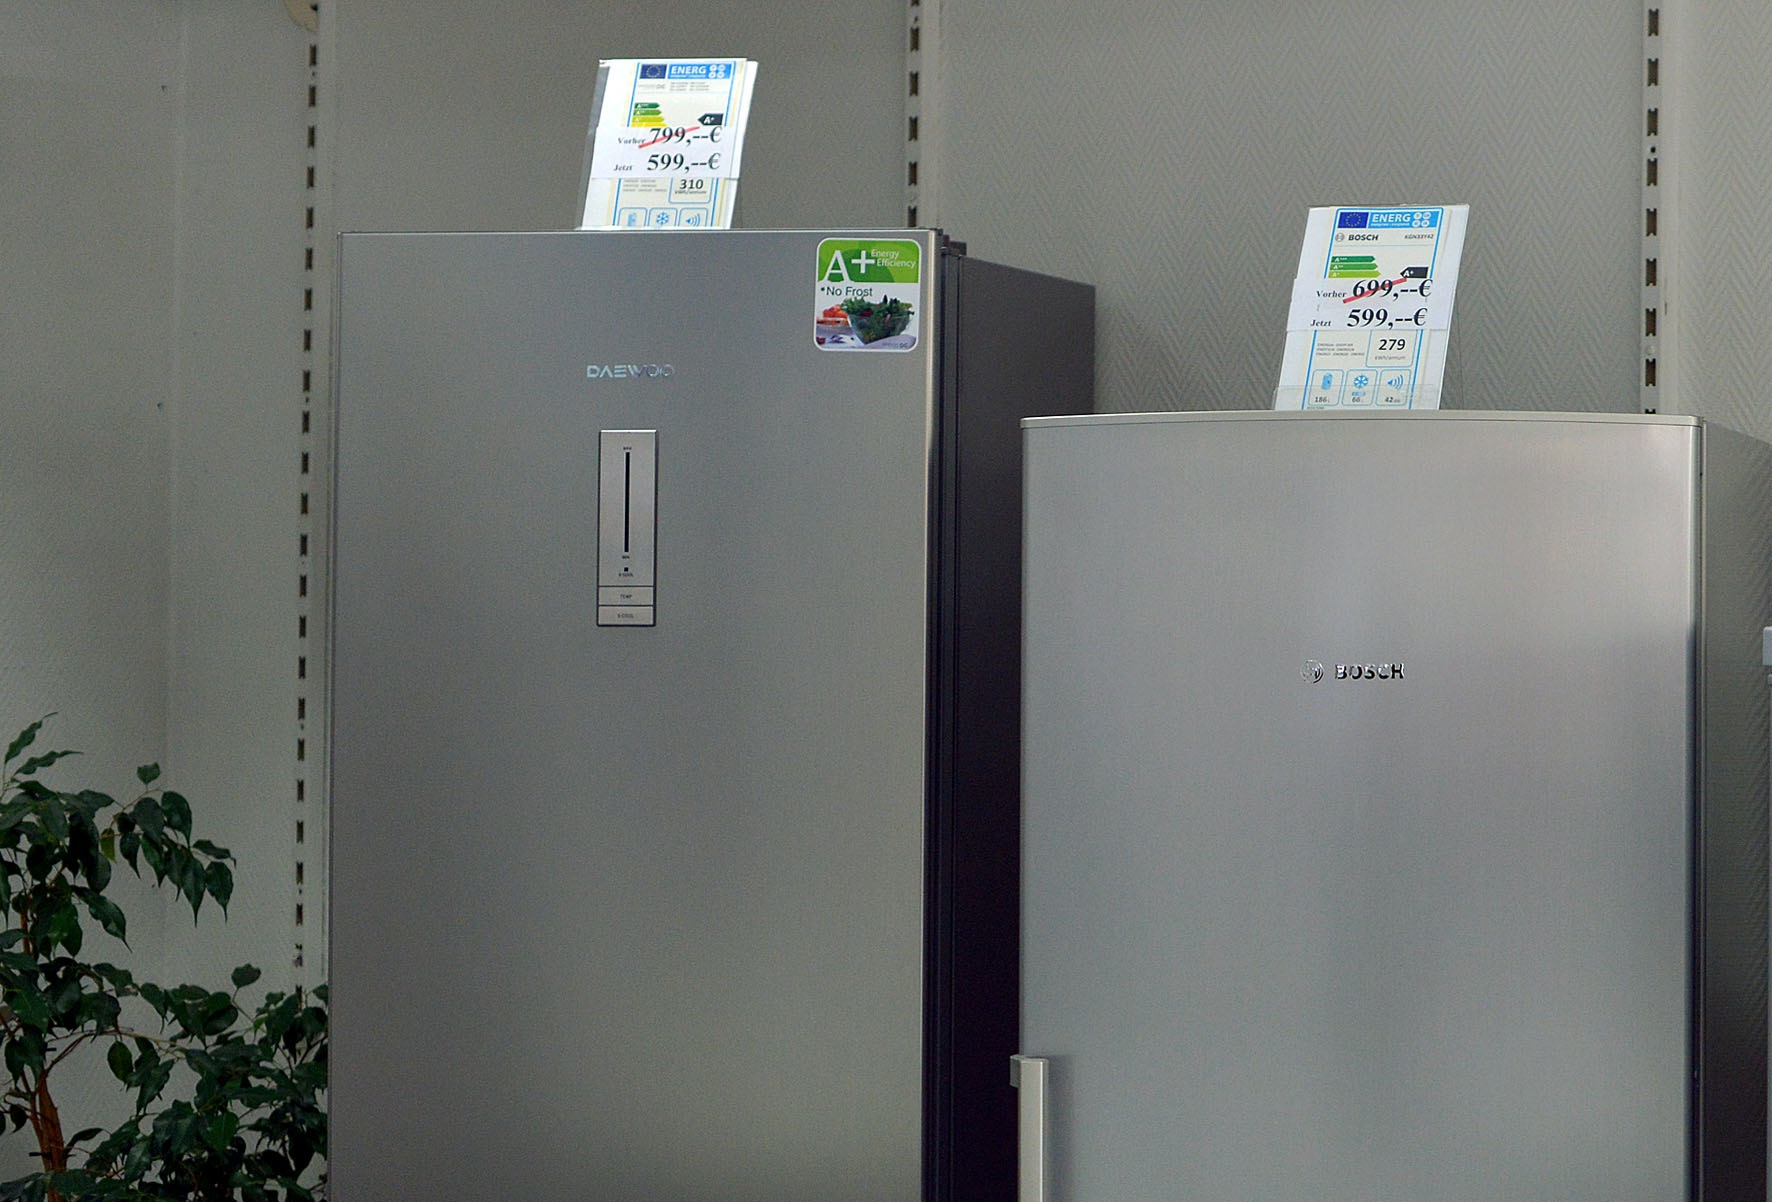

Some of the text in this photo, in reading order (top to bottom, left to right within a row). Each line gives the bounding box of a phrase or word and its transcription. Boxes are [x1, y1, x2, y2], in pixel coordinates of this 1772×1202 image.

[671, 64, 706, 74] ENERG
[679, 179, 703, 189] 310
[1372, 214, 1411, 222] ENERG
[871, 249, 899, 259] Energy
[822, 250, 875, 282] A+
[877, 259, 916, 268] Efficiency
[846, 287, 873, 296] Frost
[1379, 339, 1406, 350] 279
[587, 364, 675, 378] DAEWOO
[1335, 663, 1404, 679] BOSCH
